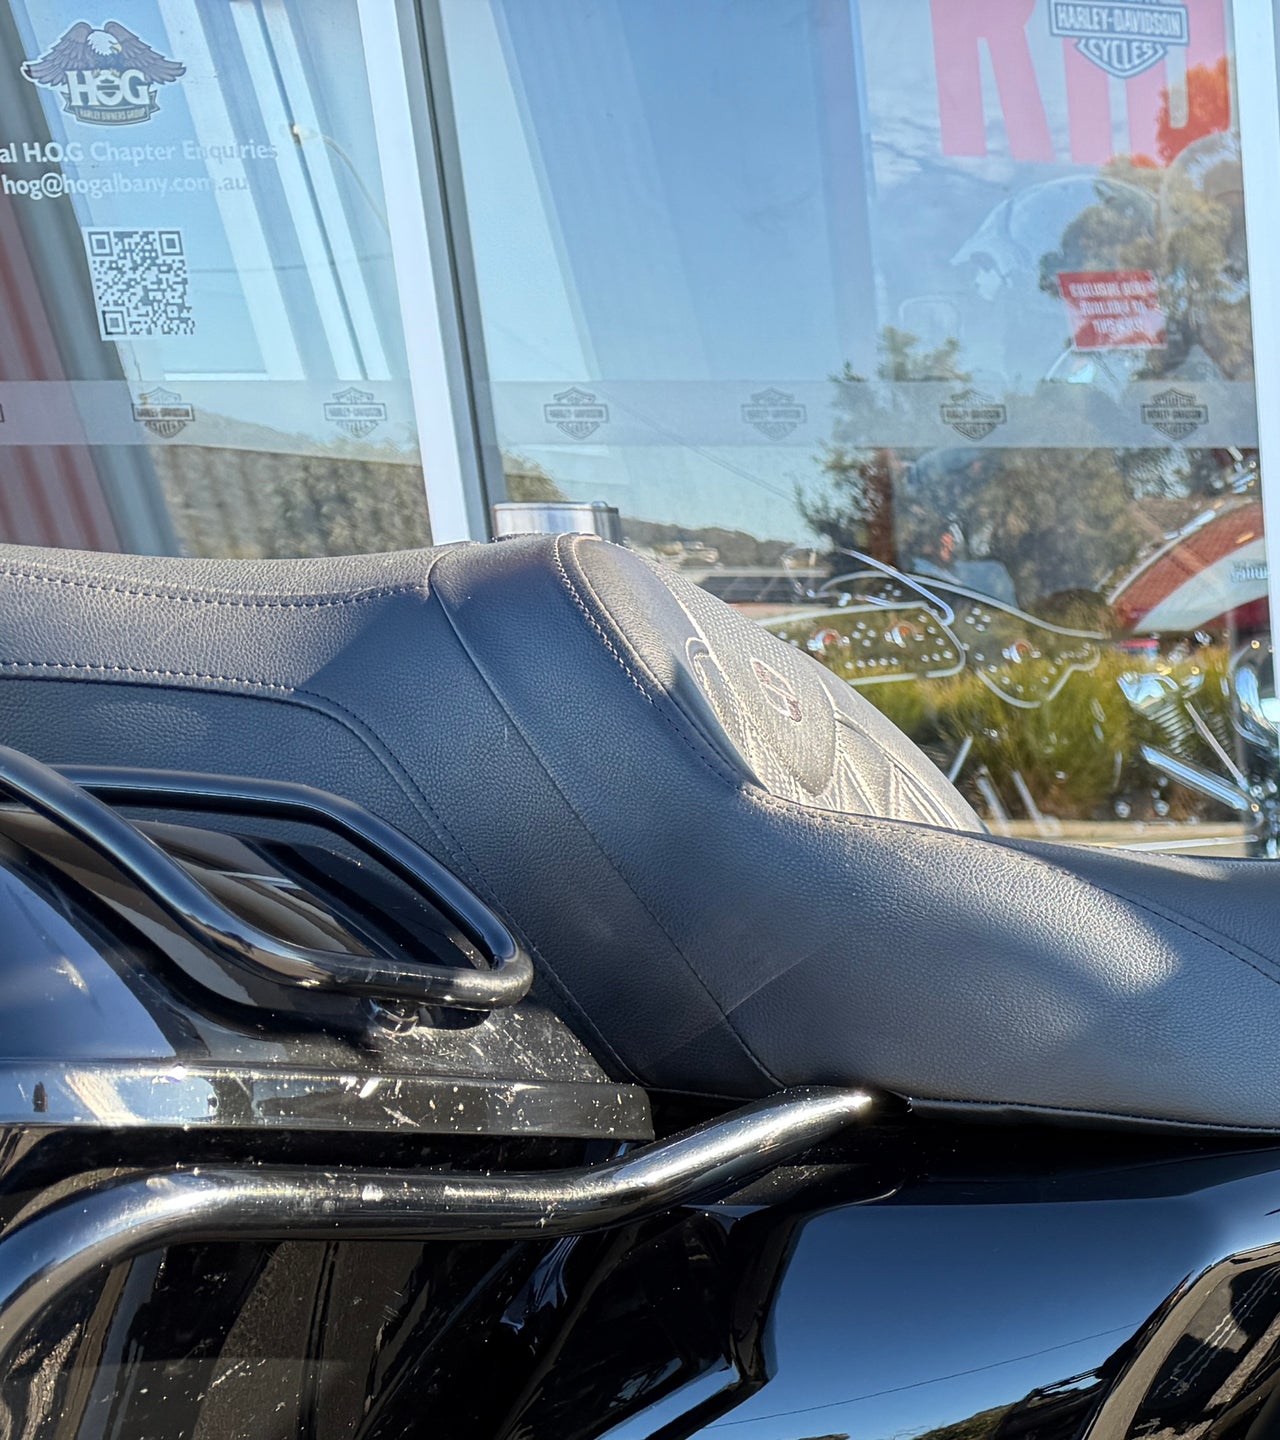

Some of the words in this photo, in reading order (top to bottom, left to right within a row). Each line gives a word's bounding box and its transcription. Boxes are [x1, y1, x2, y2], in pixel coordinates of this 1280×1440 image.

[1056, 4, 1182, 37] HARLEY-DAVIDSON
[1087, 38, 1153, 70] CYCLES
[65, 69, 150, 106] HOG
[23, 142, 84, 163] H.O.G
[91, 141, 176, 166] Chapter
[182, 140, 279, 165] Enquiries
[2, 172, 249, 200] hog@hogalbany.com.au
